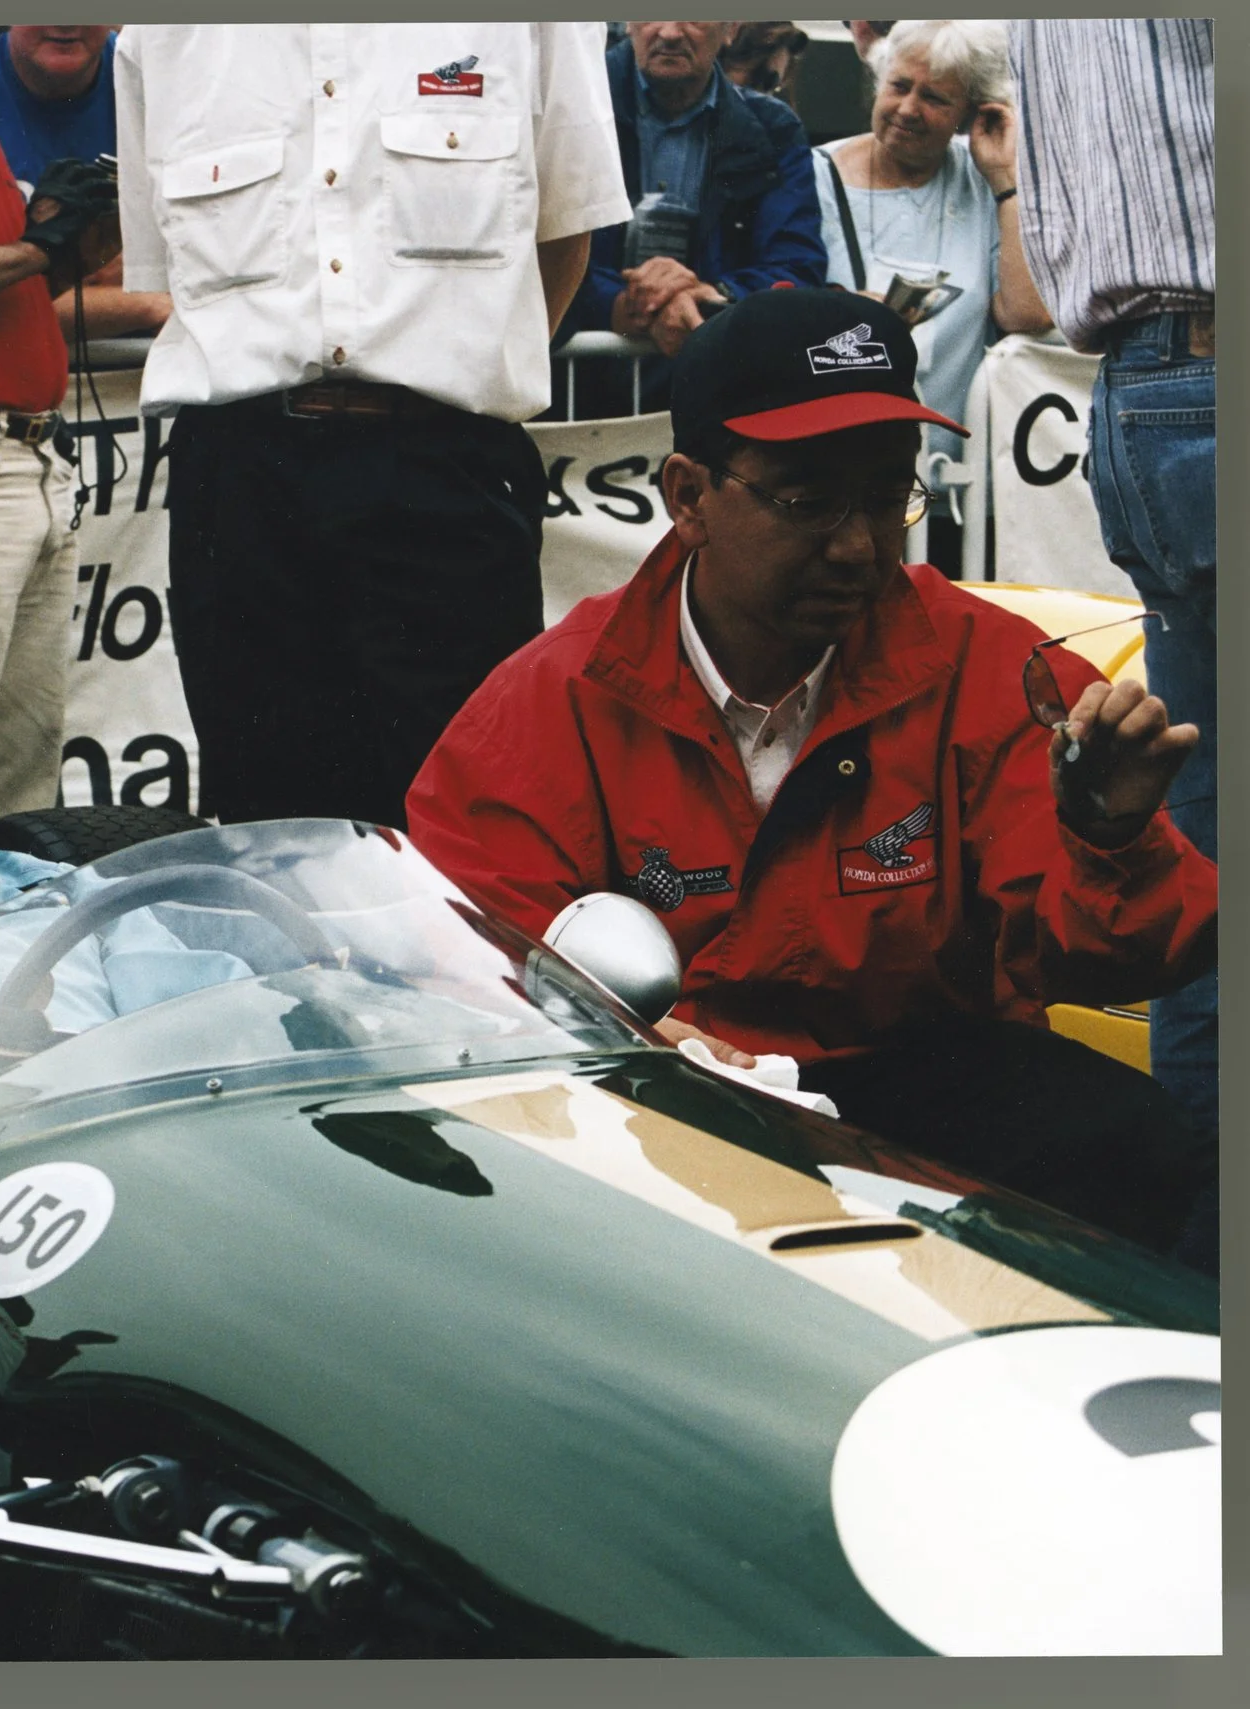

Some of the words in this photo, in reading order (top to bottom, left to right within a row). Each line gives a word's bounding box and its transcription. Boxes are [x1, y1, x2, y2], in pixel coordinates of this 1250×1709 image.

[1012, 392, 1089, 487] C
[73, 563, 163, 662] lo
[683, 870, 723, 881] WOOD
[843, 866, 876, 883] HONDA
